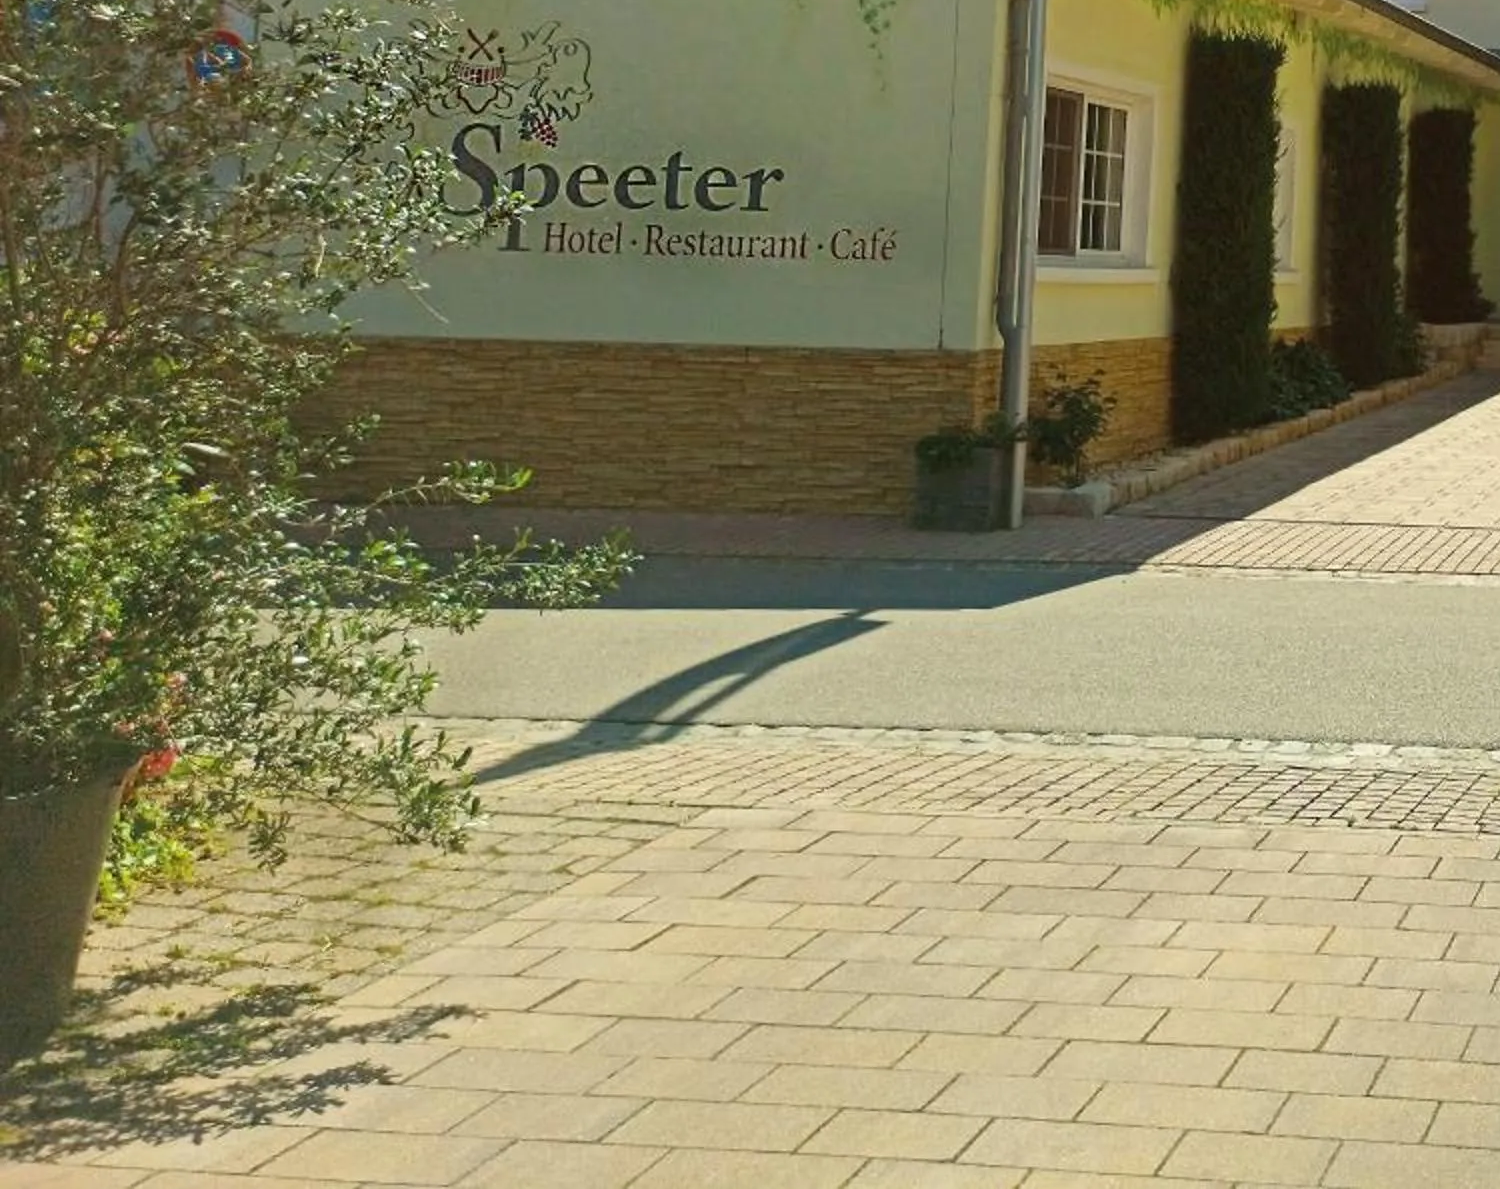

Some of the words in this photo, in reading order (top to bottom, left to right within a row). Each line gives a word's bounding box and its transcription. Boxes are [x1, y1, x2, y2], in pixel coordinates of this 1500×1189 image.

[441, 122, 785, 251] Speeter
[544, 221, 622, 255] Hotel
[644, 223, 810, 260] Restaurant
[830, 227, 897, 262] Café
